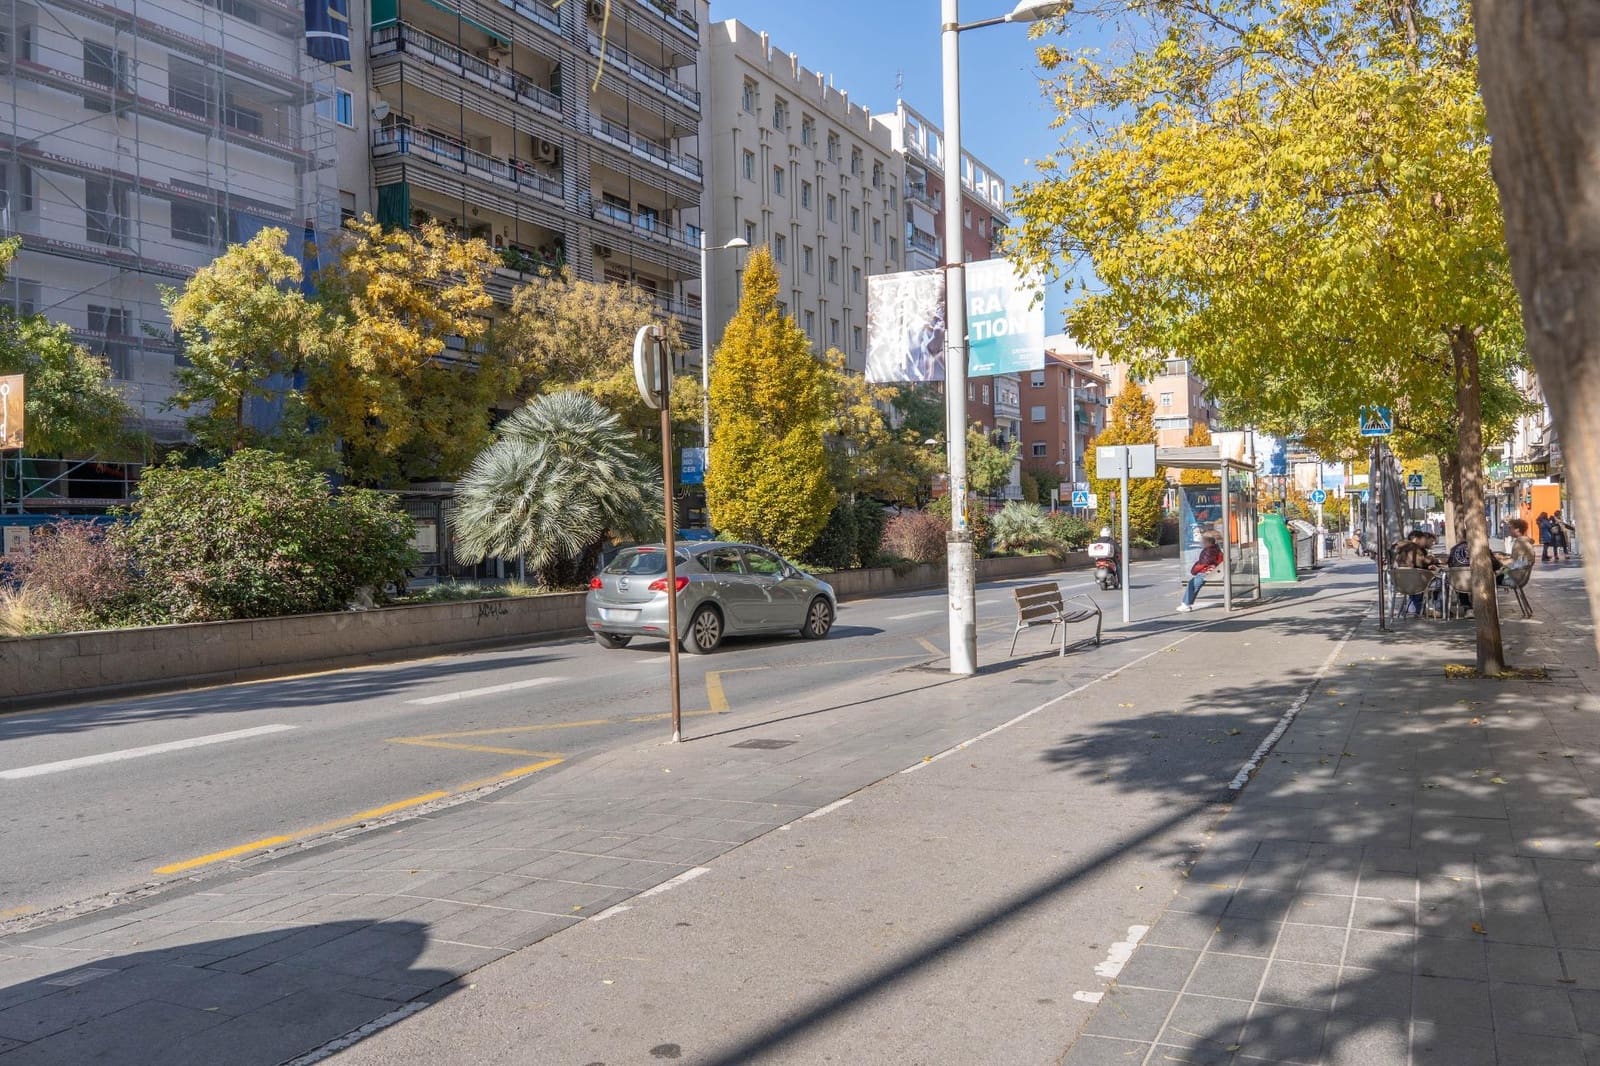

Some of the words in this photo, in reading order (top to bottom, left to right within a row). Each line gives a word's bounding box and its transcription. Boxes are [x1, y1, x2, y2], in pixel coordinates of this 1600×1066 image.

[48, 69, 109, 91] ALQUISUR
[154, 103, 206, 122] ALQUISUR
[156, 182, 208, 200] ALQUISUR
[46, 239, 107, 256] ALQUISUR
[971, 294, 1003, 316] RA
[972, 317, 1026, 340] TION
